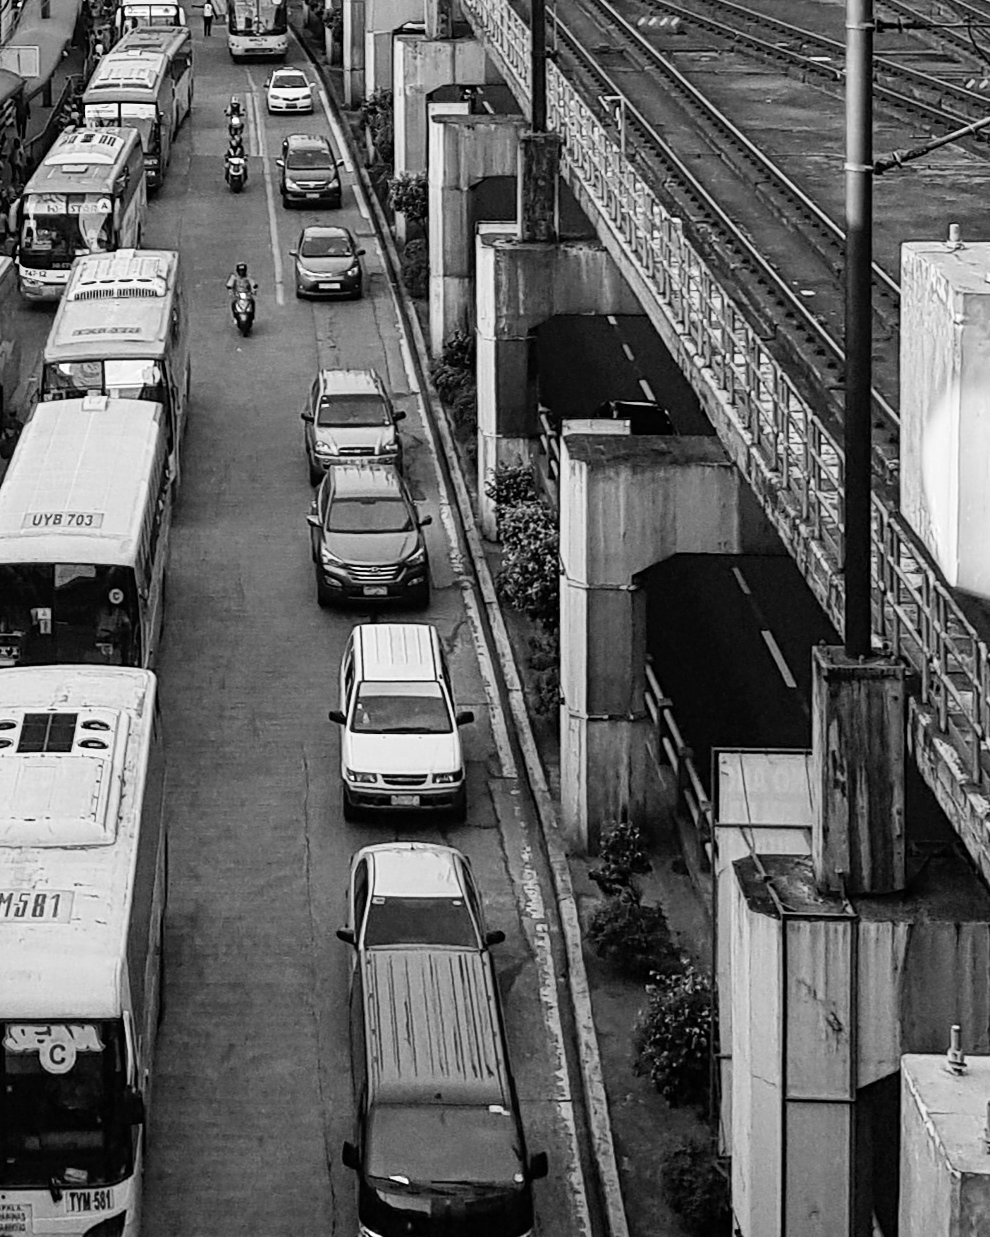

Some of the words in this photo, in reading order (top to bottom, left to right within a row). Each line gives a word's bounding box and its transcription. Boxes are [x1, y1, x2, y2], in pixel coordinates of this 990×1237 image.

[32, 513, 63, 526] UYB
[67, 513, 94, 526] 703
[49, 1044, 66, 1065] C
